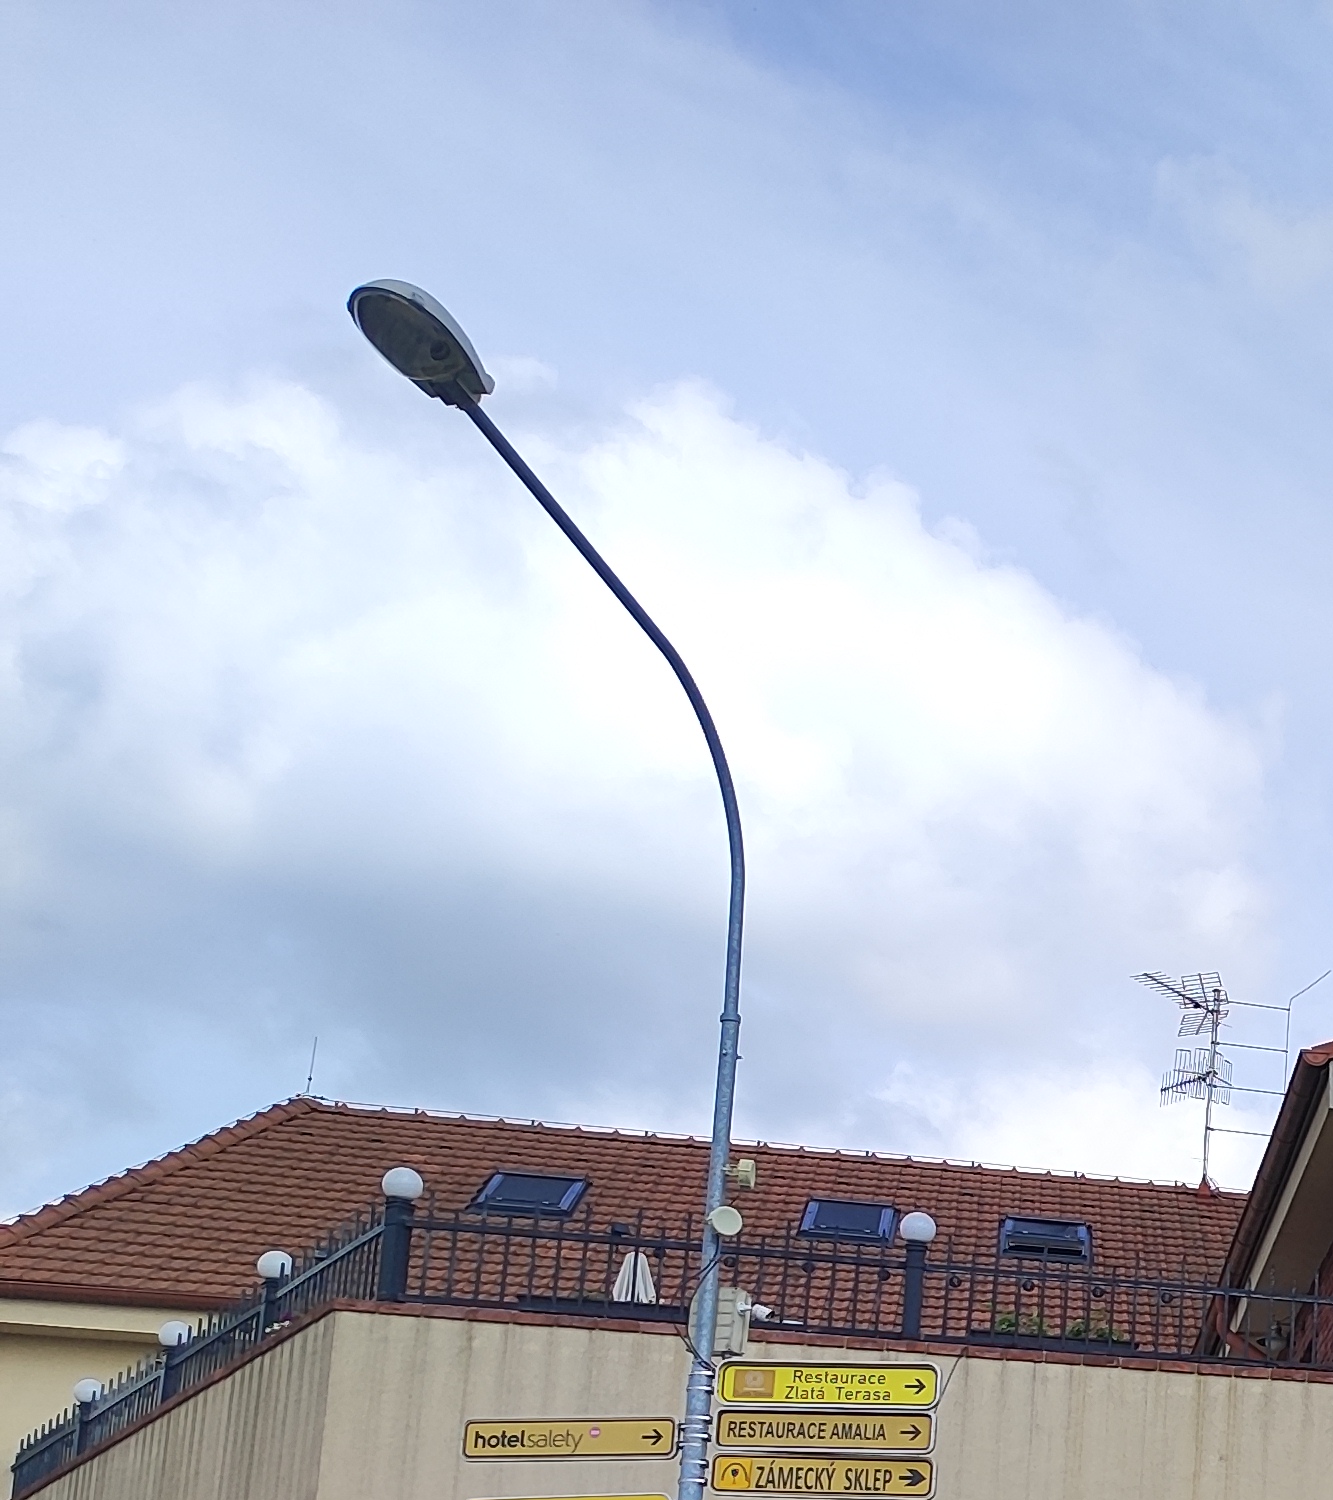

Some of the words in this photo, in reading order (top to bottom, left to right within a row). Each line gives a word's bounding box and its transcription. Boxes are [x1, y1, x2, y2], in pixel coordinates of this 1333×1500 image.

[792, 1369, 887, 1385] Restaurace
[784, 1385, 825, 1400] Zlatá
[834, 1386, 891, 1401] Terasa
[726, 1420, 827, 1441] RESTAURACE
[829, 1423, 887, 1442] AMALIA
[755, 1460, 836, 1491] ZÁMECKÝ
[843, 1468, 893, 1492] SKLEP
